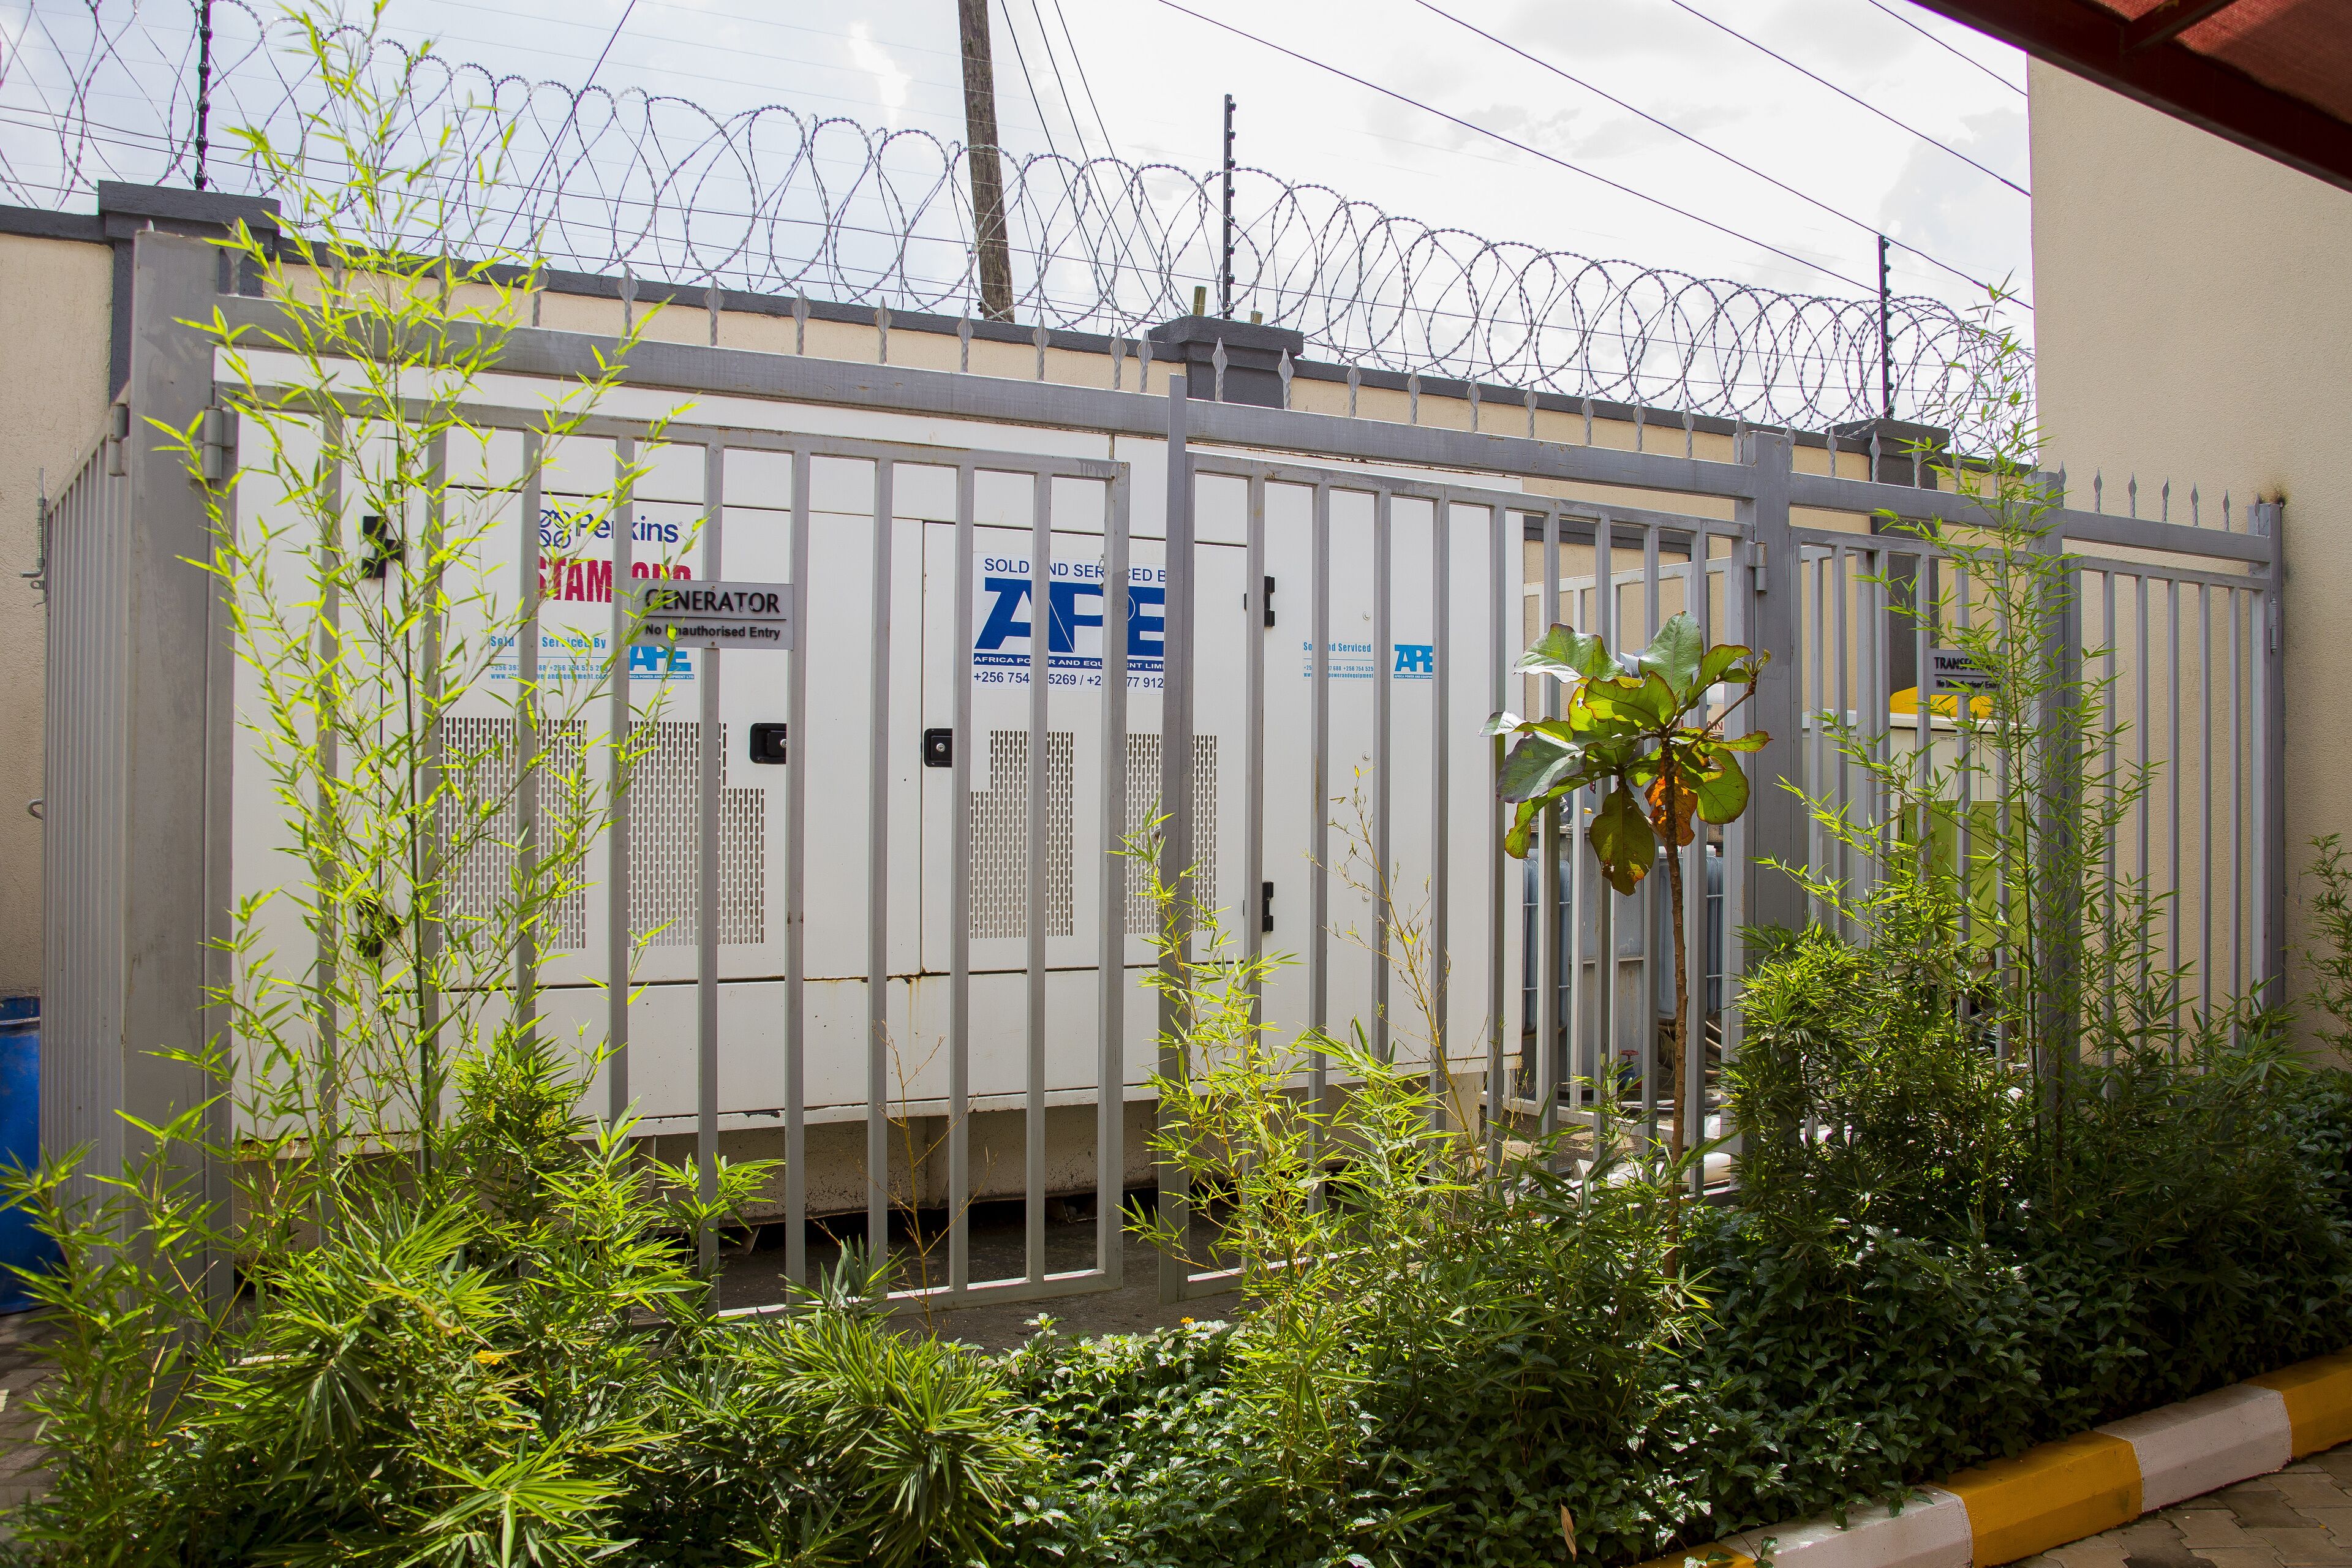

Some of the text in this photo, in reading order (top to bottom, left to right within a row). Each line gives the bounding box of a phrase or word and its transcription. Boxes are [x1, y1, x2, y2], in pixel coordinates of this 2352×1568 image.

[576, 512, 679, 543] Pekins
[539, 555, 691, 603] STAM
[984, 558, 1030, 573] SOLD
[1049, 562, 1068, 576] ND
[1073, 564, 1152, 581] SERED
[646, 589, 780, 613] GENERATOR
[646, 624, 662, 635] No
[750, 627, 781, 641] Entry
[491, 636, 607, 650] Sold Serice By
[1338, 643, 1371, 652] Serviced
[630, 646, 692, 671] APE
[1084, 660, 1142, 669] EQUENT
[974, 671, 1004, 683] +256
[1008, 673, 1030, 684] 754
[1048, 674, 1076, 685] 5269
[1087, 676, 1101, 687] +2
